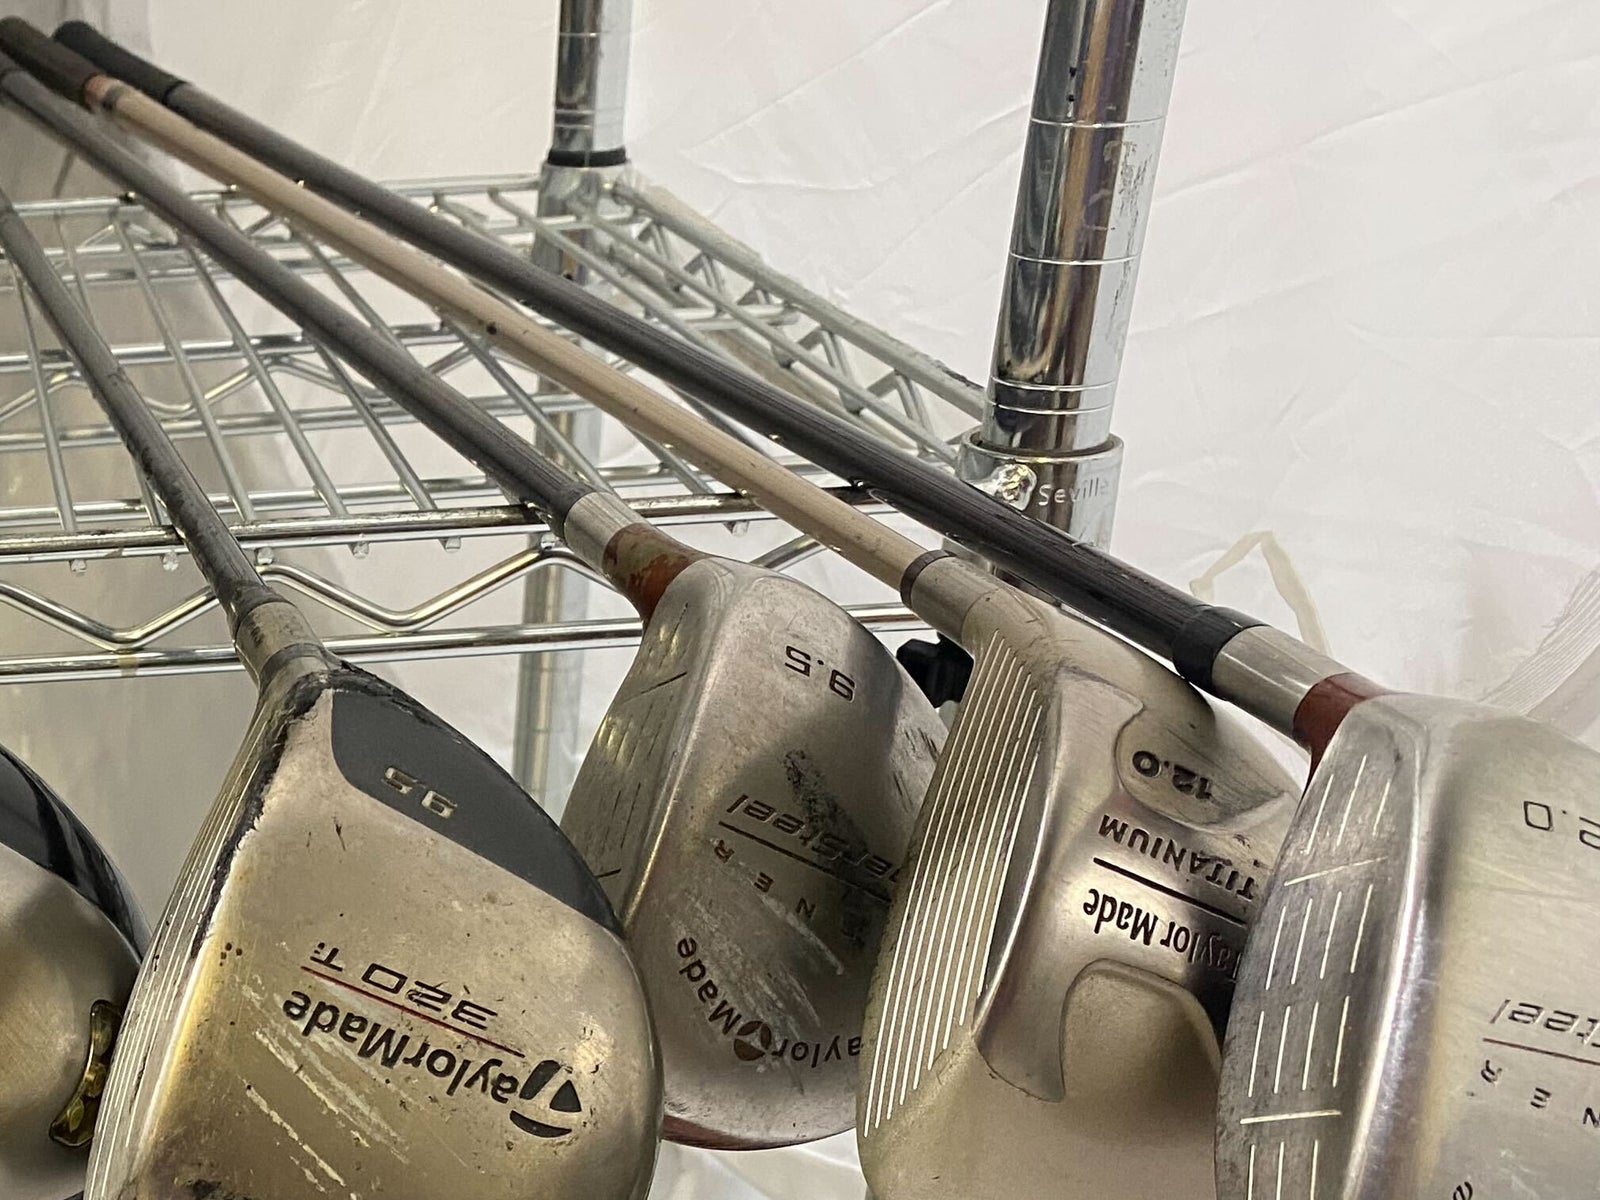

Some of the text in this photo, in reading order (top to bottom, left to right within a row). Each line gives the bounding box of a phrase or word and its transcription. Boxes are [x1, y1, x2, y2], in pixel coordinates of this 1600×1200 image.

[1038, 476, 1109, 506] Seville
[783, 645, 856, 702] 9.5
[1132, 750, 1213, 799] 12.0
[1523, 800, 1600, 850] 2.0
[1098, 814, 1256, 901] TITANIUM
[1082, 888, 1159, 946] Made
[362, 962, 499, 1030] 320
[282, 990, 583, 1139] TaylorMade
